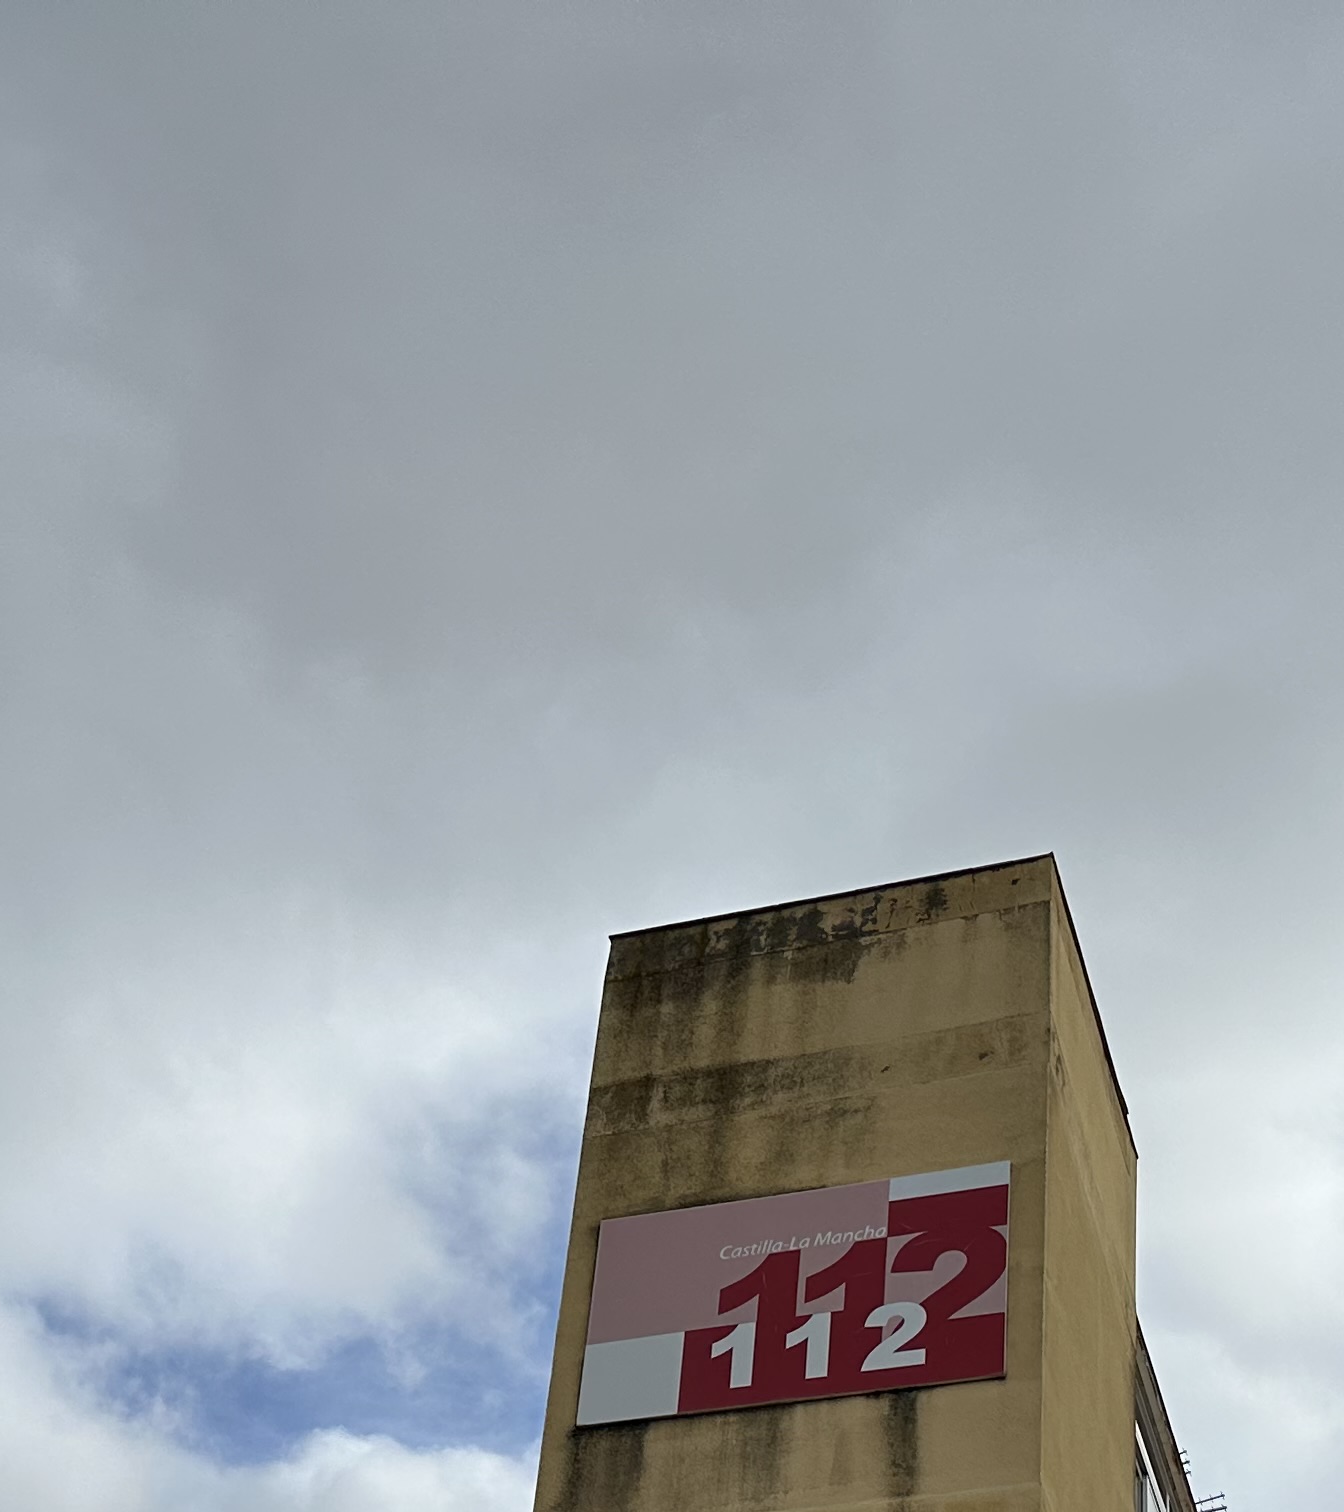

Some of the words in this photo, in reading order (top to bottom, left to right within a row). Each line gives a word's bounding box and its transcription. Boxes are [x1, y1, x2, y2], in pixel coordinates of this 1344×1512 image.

[718, 1227, 1008, 1328] 112
[719, 1235, 809, 1260] Castilla-La
[814, 1225, 887, 1247] Mancha
[710, 1302, 927, 1389] 112
